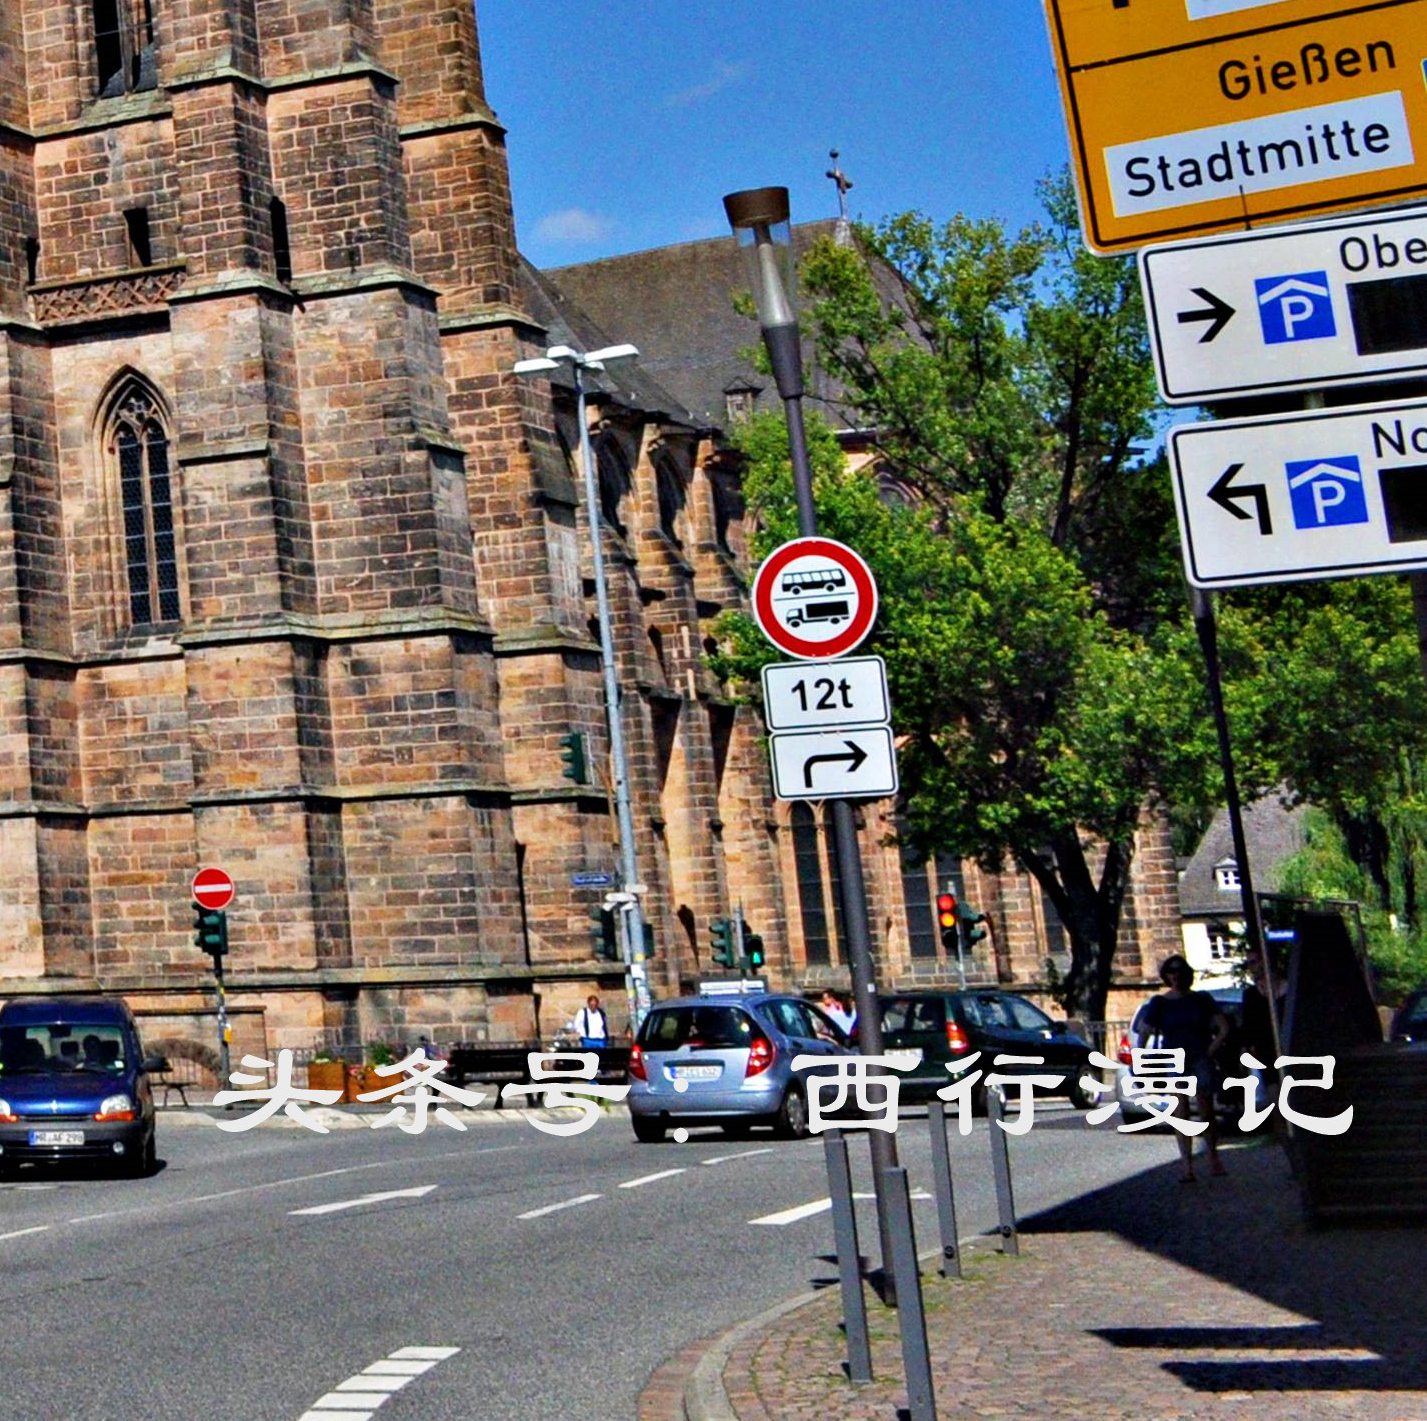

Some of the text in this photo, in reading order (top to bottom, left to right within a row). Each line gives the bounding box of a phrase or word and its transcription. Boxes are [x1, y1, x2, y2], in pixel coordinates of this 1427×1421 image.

[1219, 39, 1396, 100] Gießen
[1125, 120, 1390, 197] Stadtmitte
[1339, 233, 1427, 272] Obe
[1280, 294, 1314, 339] P
[1312, 479, 1346, 524] P
[791, 676, 854, 712] 12t
